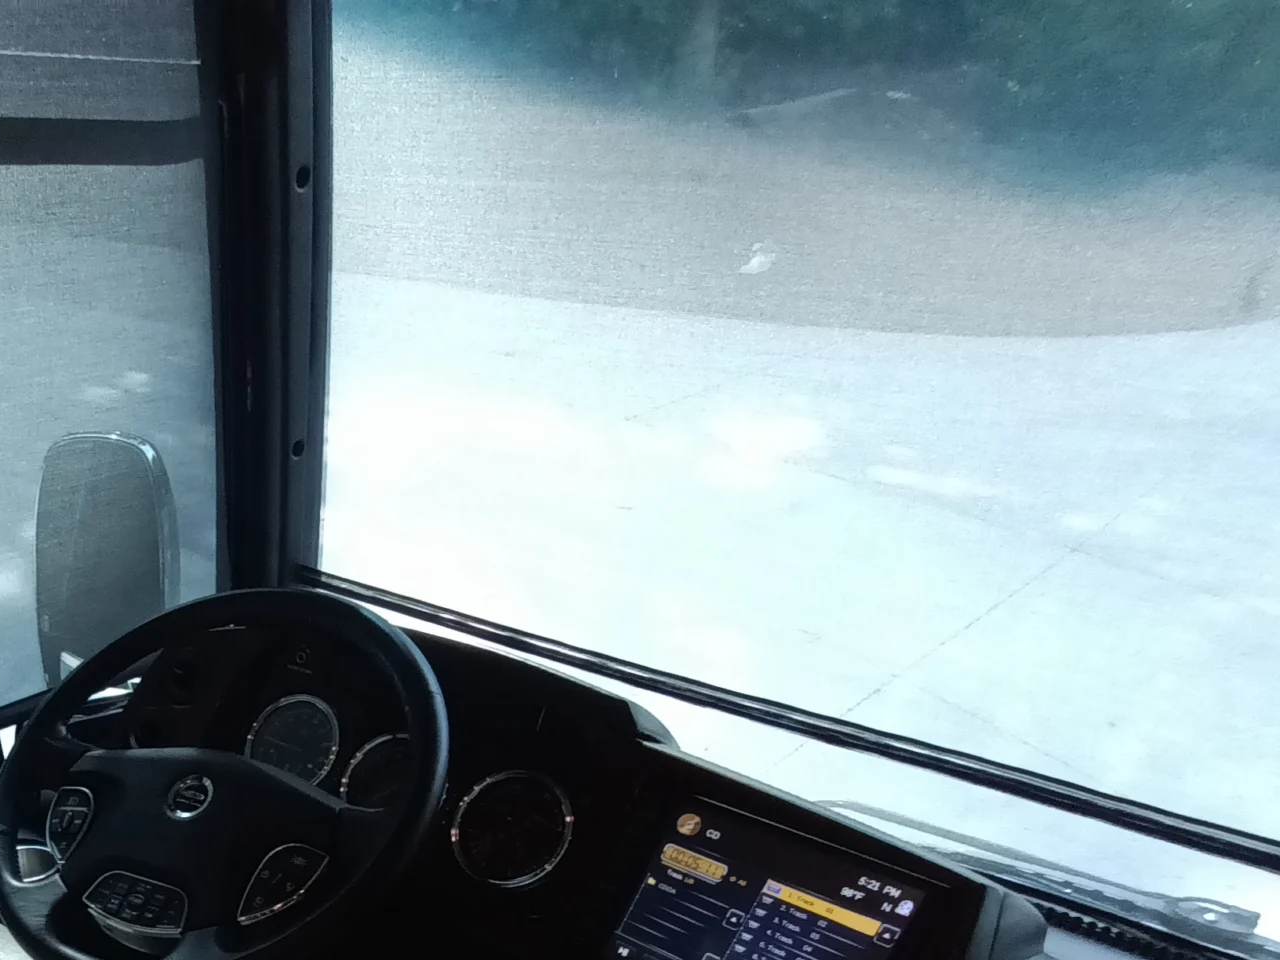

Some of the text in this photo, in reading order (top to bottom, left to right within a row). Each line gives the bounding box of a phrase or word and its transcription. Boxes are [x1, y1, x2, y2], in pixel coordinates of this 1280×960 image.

[705, 829, 721, 840] CD
[667, 869, 683, 881] Track
[857, 876, 902, 899] 5:21 PM
[796, 895, 815, 907] Track
[880, 902, 893, 912] N
[789, 907, 808, 920] Track
[817, 919, 828, 928] 02
[781, 919, 801, 933] Track
[774, 932, 793, 945] Track
[802, 944, 813, 953] 04
[767, 944, 787, 957] Track
